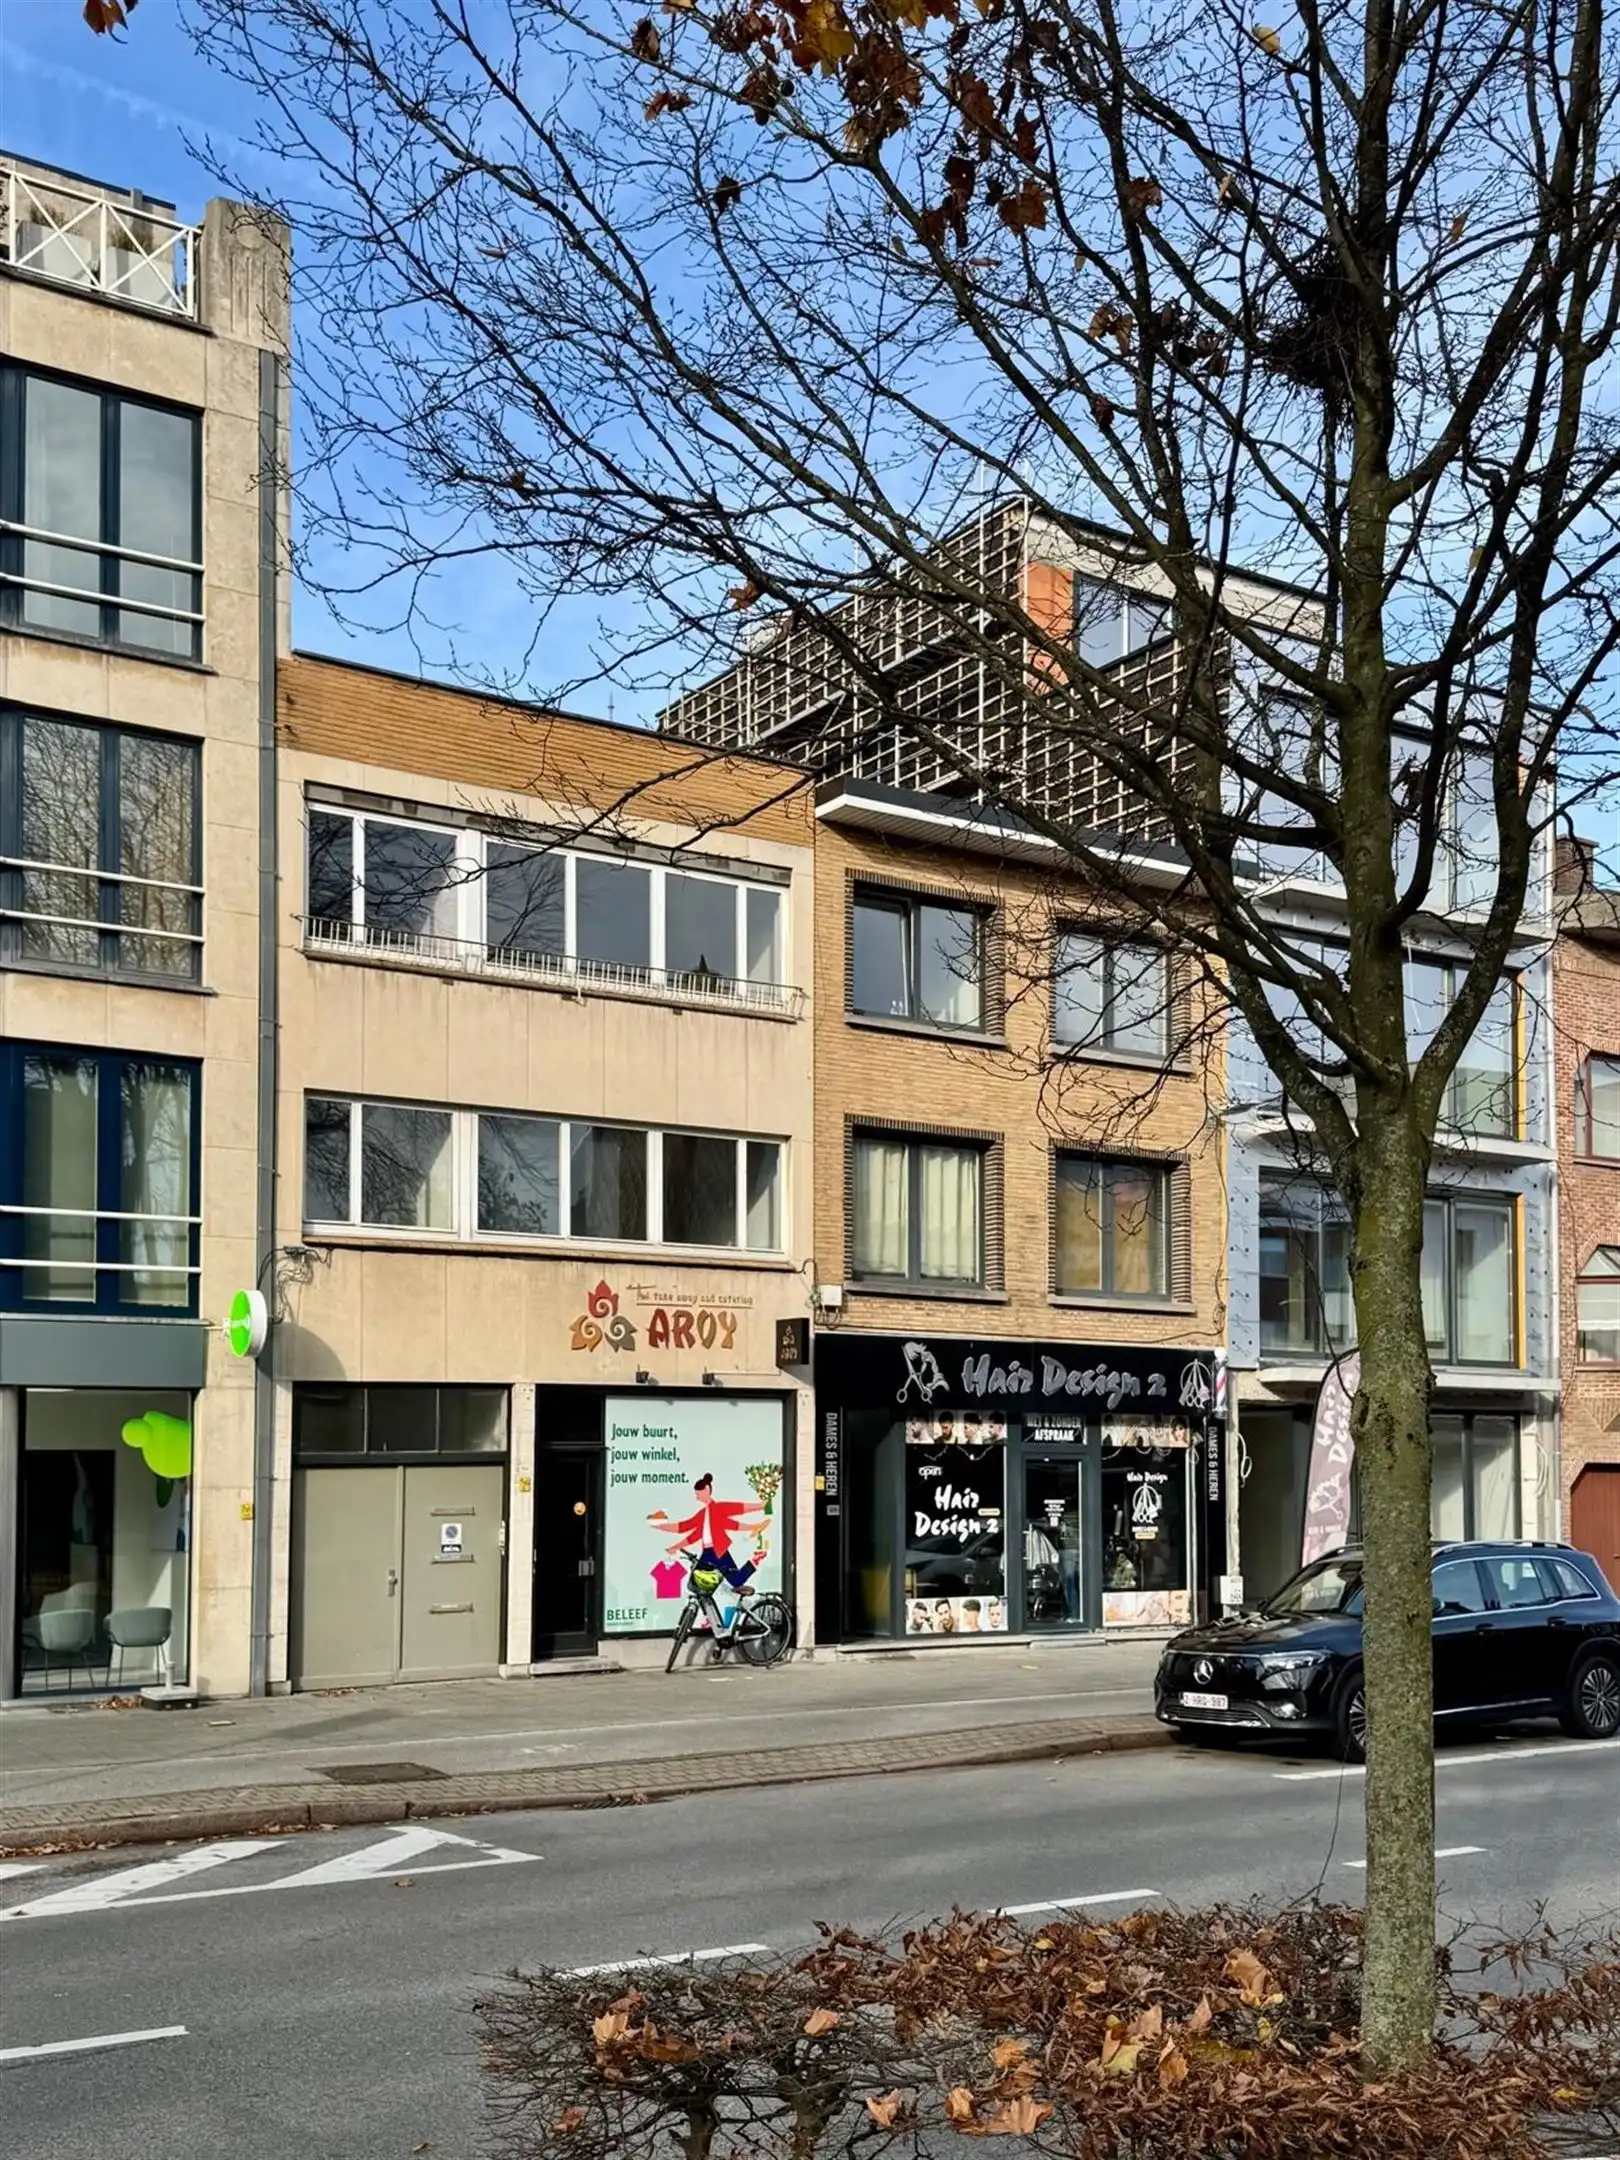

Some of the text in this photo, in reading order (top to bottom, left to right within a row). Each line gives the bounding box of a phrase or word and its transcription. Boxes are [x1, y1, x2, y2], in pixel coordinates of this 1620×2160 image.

[654, 1292, 673, 1302] take
[677, 1294, 698, 1304] away
[700, 1294, 715, 1303] and
[718, 1295, 754, 1306] catering
[646, 1308, 738, 1350] AROY
[961, 1353, 1168, 1410] Hair Design 2
[611, 1423, 678, 1441] Jouw buurt,
[1034, 1428, 1075, 1441] AFSPRAAK
[610, 1446, 680, 1464] jouw winkel,
[825, 1412, 838, 1497] DAMES & HEREN
[1207, 1426, 1219, 1501] DAMES & HEREN
[610, 1469, 689, 1488] jouw moment.
[918, 1465, 943, 1480] open
[934, 1483, 980, 1511] Hair
[914, 1511, 1000, 1543] Design 2
[607, 1608, 648, 1621] BELEEF
